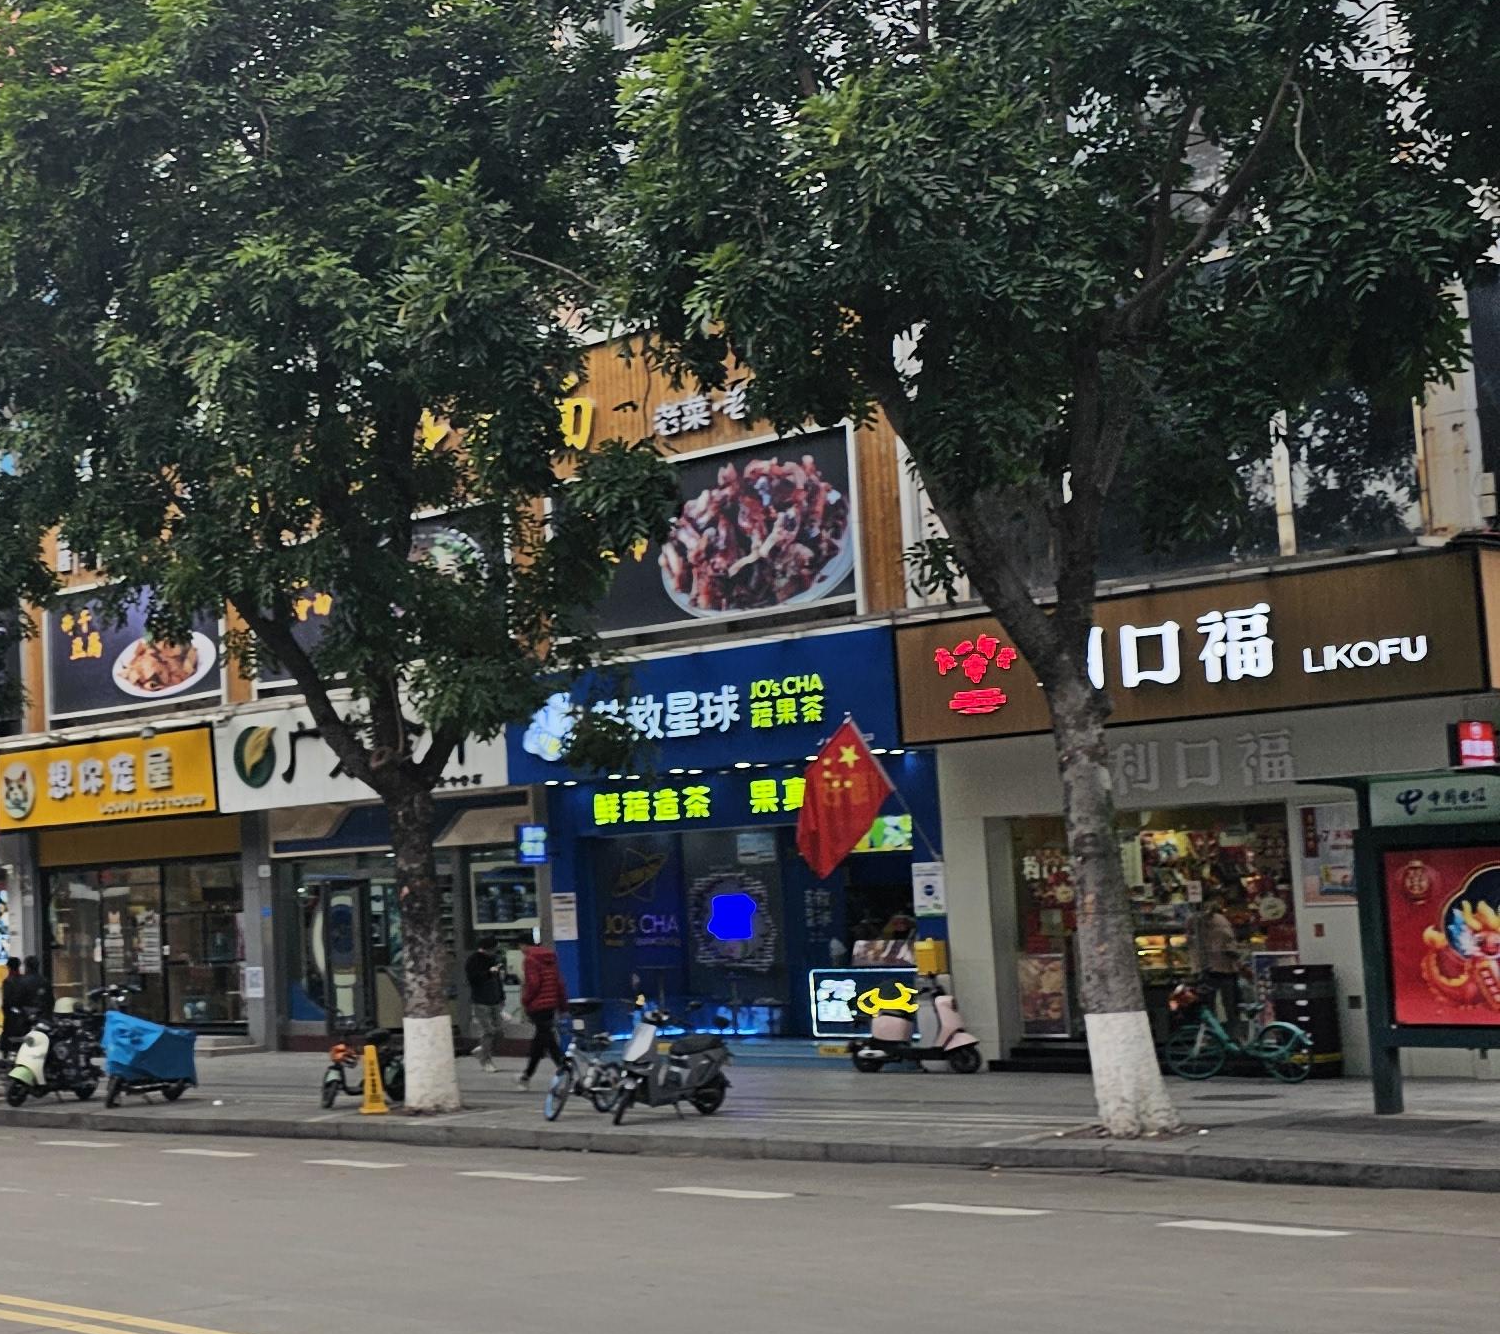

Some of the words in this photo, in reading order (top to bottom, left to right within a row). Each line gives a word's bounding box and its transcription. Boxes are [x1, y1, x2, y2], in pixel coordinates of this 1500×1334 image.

[1302, 634, 1429, 674] LIKOFU
[781, 673, 825, 695] CHA
[750, 694, 825, 730] 蔬果茶
